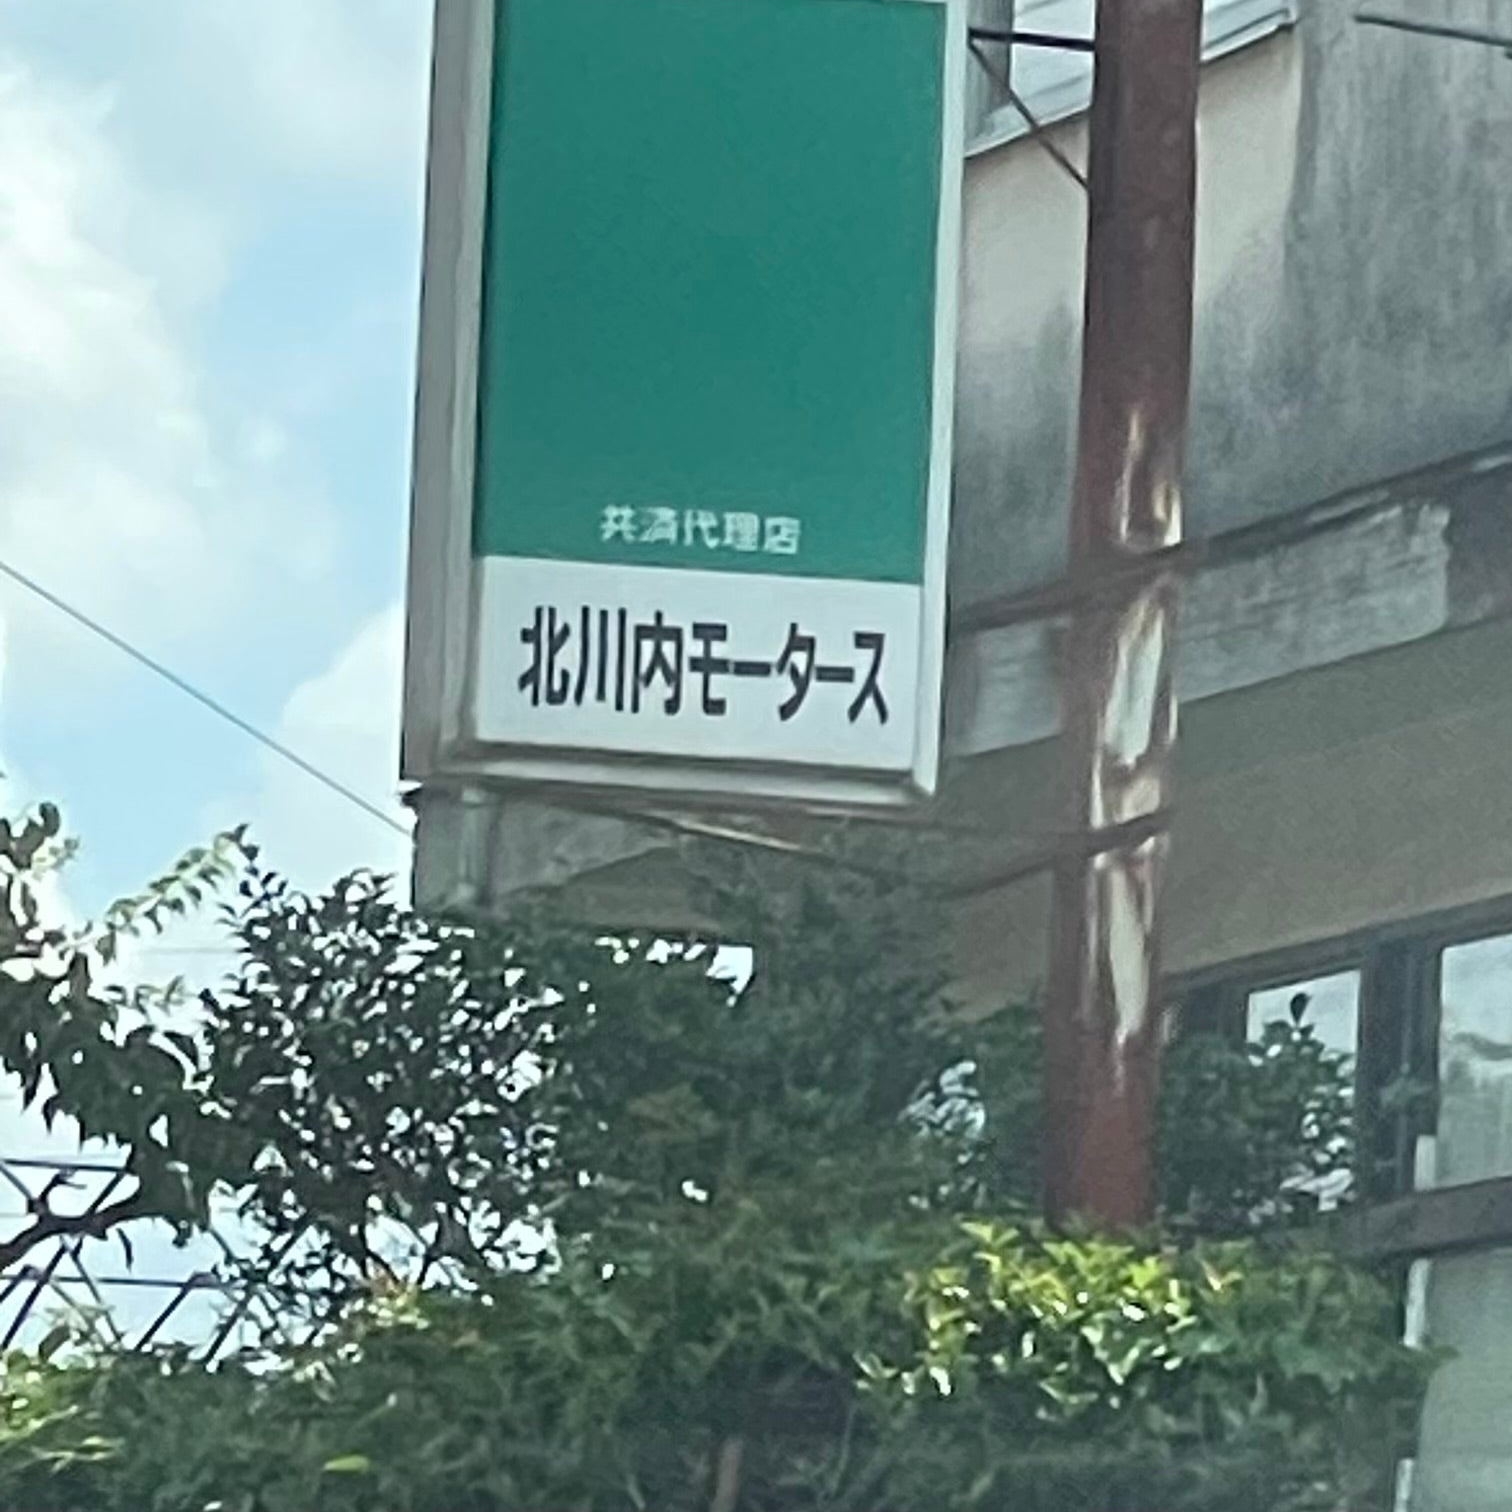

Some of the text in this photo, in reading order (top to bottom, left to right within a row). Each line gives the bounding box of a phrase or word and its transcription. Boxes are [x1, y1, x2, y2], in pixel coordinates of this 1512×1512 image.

[599, 504, 801, 556] 共済代理店
[517, 604, 889, 726] 北川内モータース
